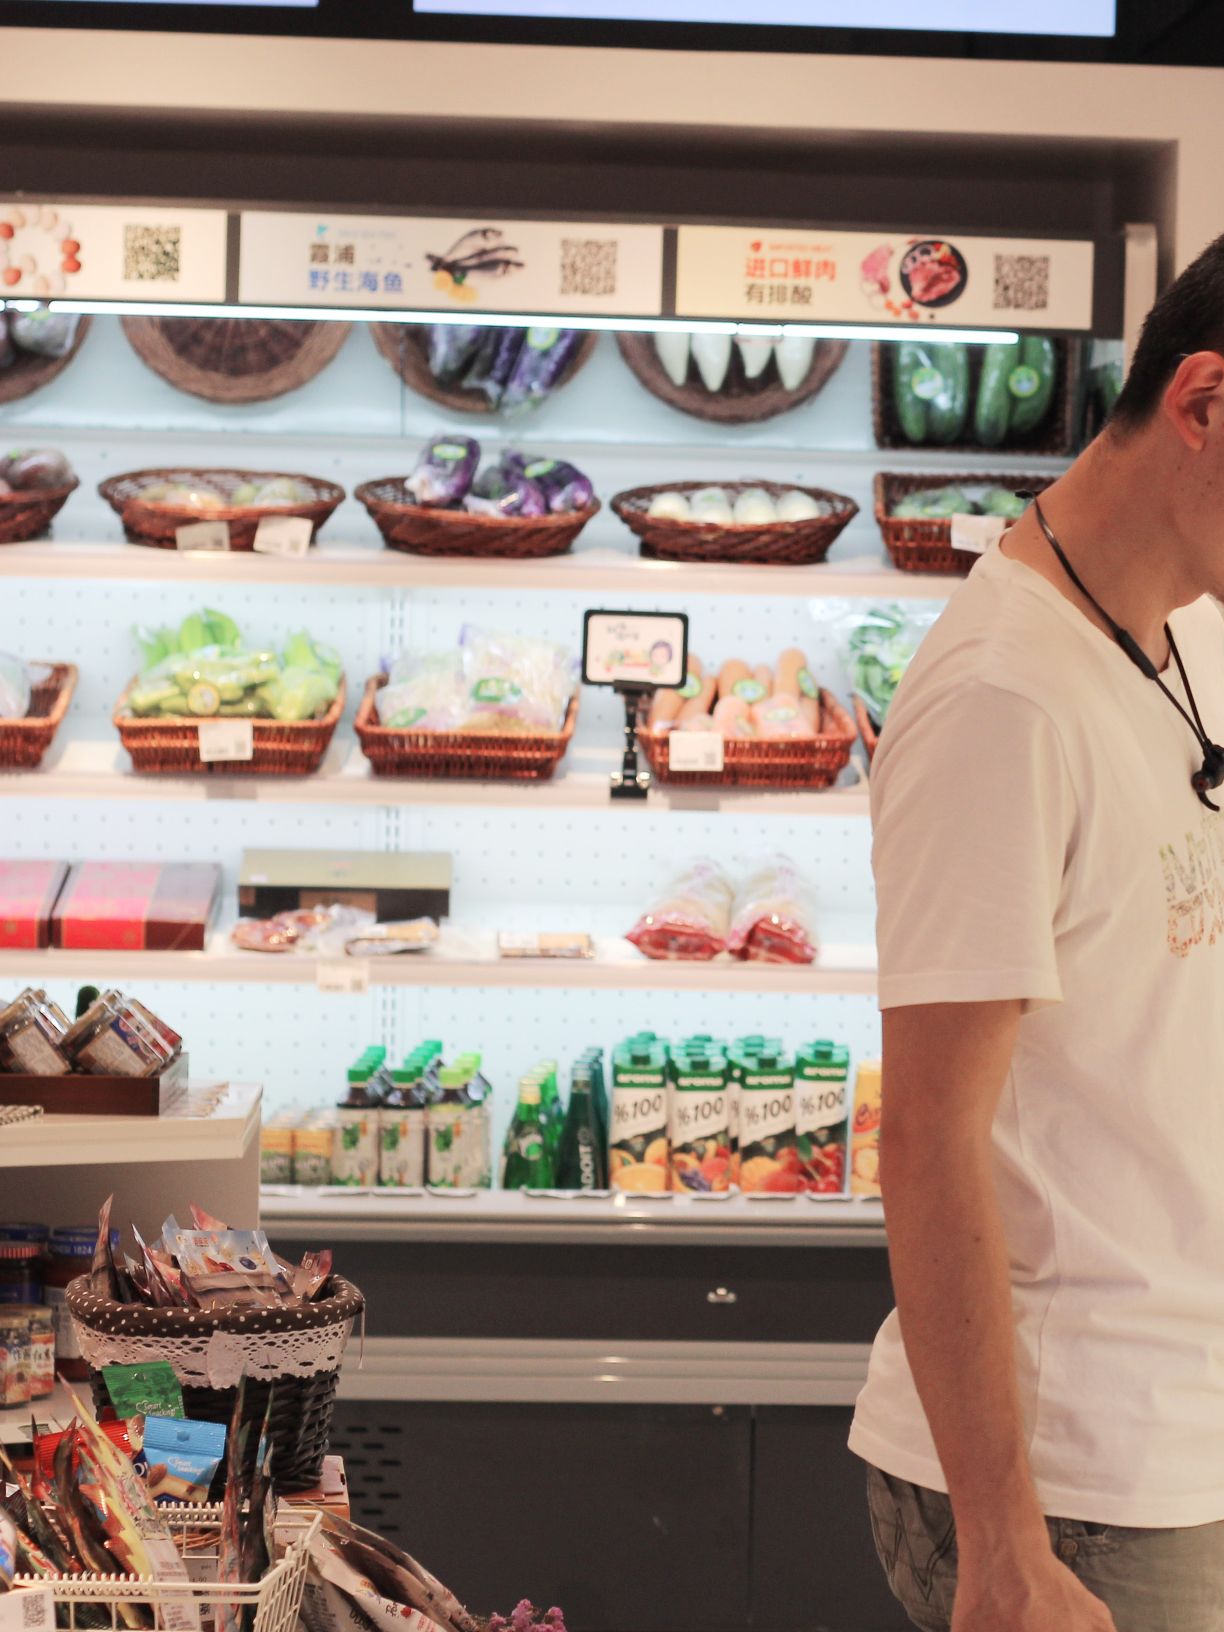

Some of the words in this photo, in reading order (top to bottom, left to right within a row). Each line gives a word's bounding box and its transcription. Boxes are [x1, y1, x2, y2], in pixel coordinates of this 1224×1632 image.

[745, 258, 837, 281] 进口鲜肉
[308, 270, 403, 293] 野生海鱼
